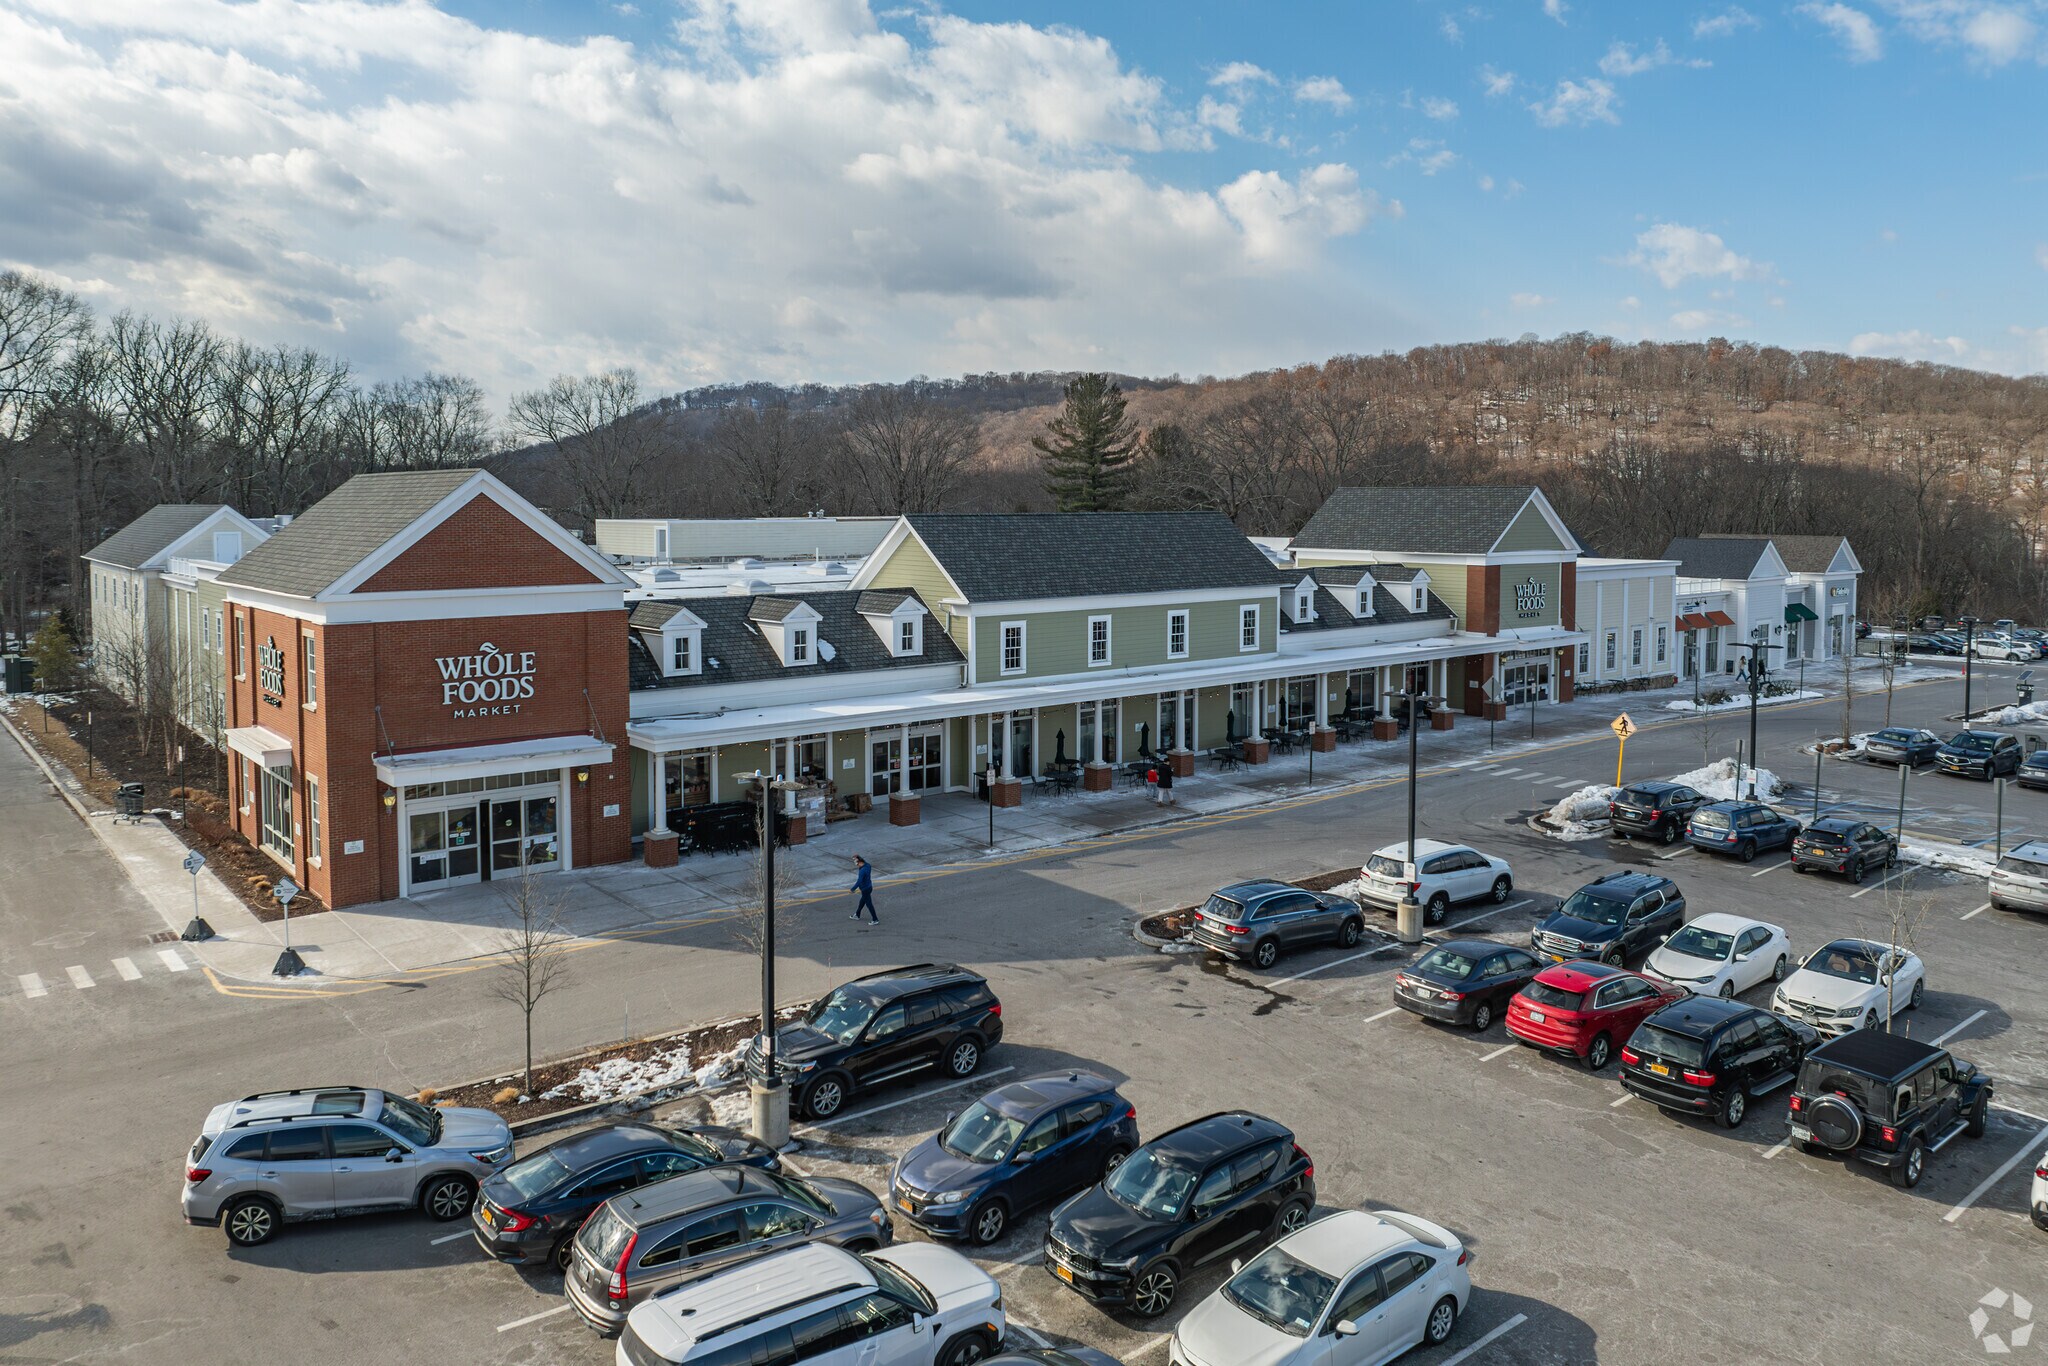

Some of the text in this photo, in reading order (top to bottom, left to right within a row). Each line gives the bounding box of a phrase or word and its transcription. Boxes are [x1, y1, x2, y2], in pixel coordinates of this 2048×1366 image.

[1516, 582, 1546, 597] WHOLE
[1517, 597, 1546, 610] FOODS
[258, 644, 283, 672] WHOLE
[435, 650, 537, 680] WHOLE
[260, 668, 283, 696] FOODS
[442, 676, 535, 705] FOODS
[454, 704, 521, 719] MARKET
